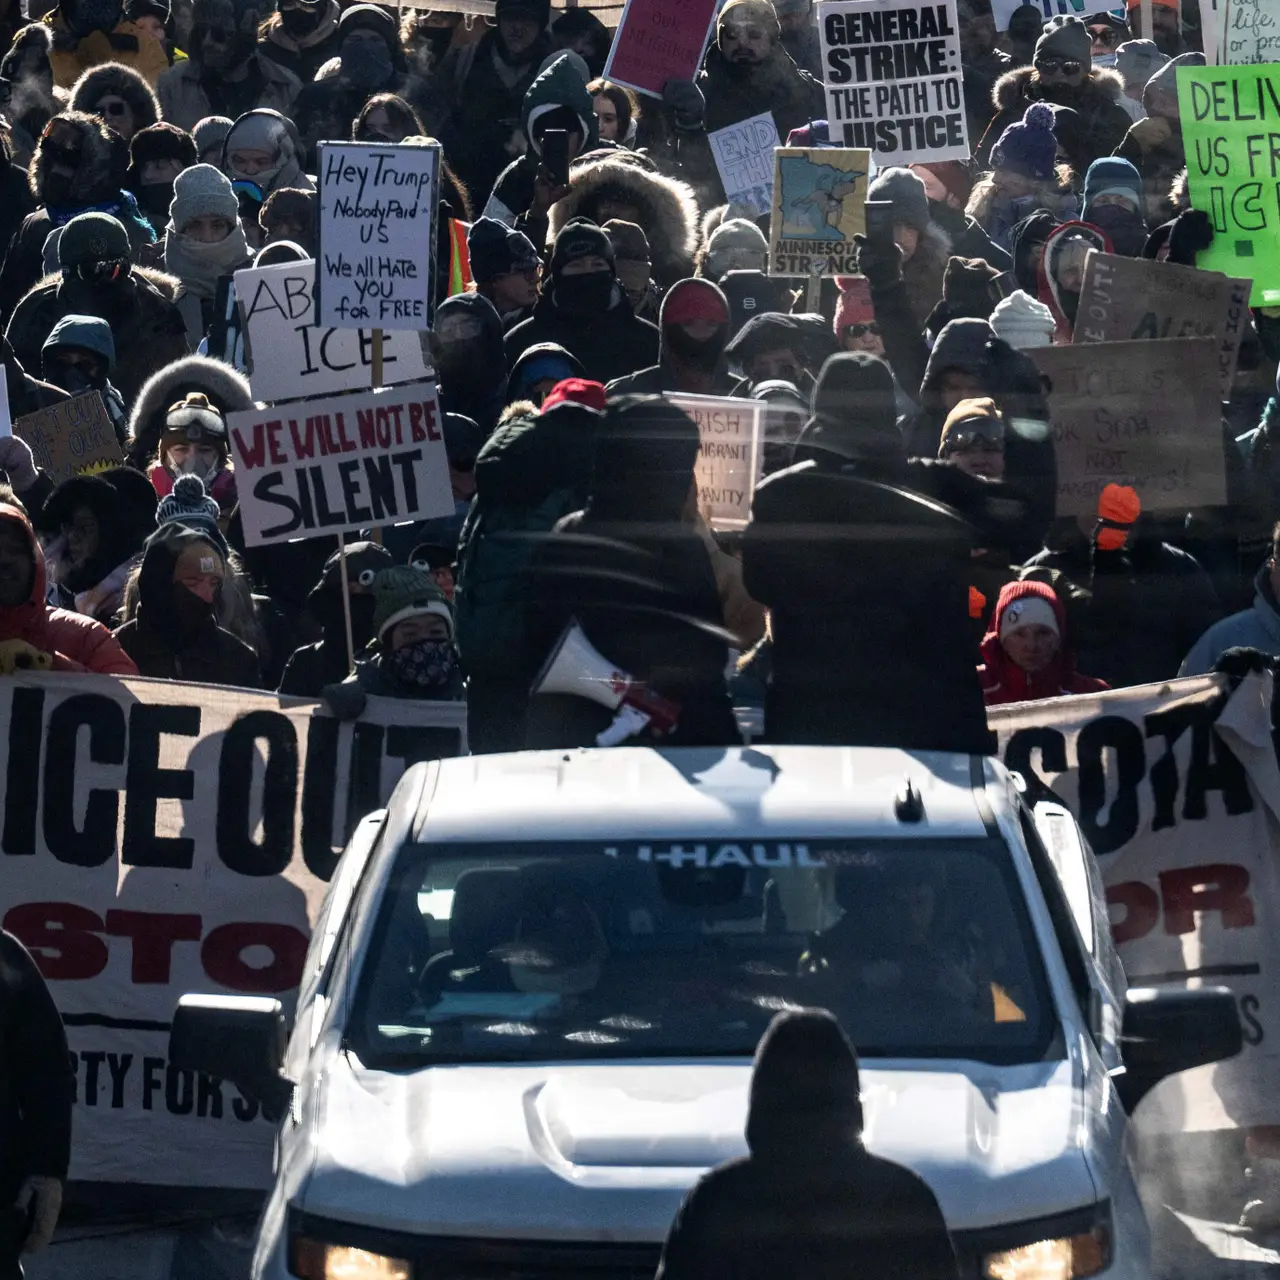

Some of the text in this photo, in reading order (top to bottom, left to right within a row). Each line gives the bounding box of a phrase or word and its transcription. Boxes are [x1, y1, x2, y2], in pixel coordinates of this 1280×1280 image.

[824, 4, 954, 45] GENERAL
[827, 41, 958, 84] STRIKE:
[830, 78, 959, 119] THE PATH TO
[833, 112, 965, 154] JUSTICE
[325, 151, 429, 192] Hey Trump
[1195, 137, 1229, 176] US
[334, 198, 417, 220] Nobody Paid
[379, 299, 423, 317] FREE
[294, 323, 397, 375] ICE
[231, 401, 441, 470] WE WILL NOT BE
[252, 451, 422, 538] SILENT
[2, 686, 202, 869] ICE
